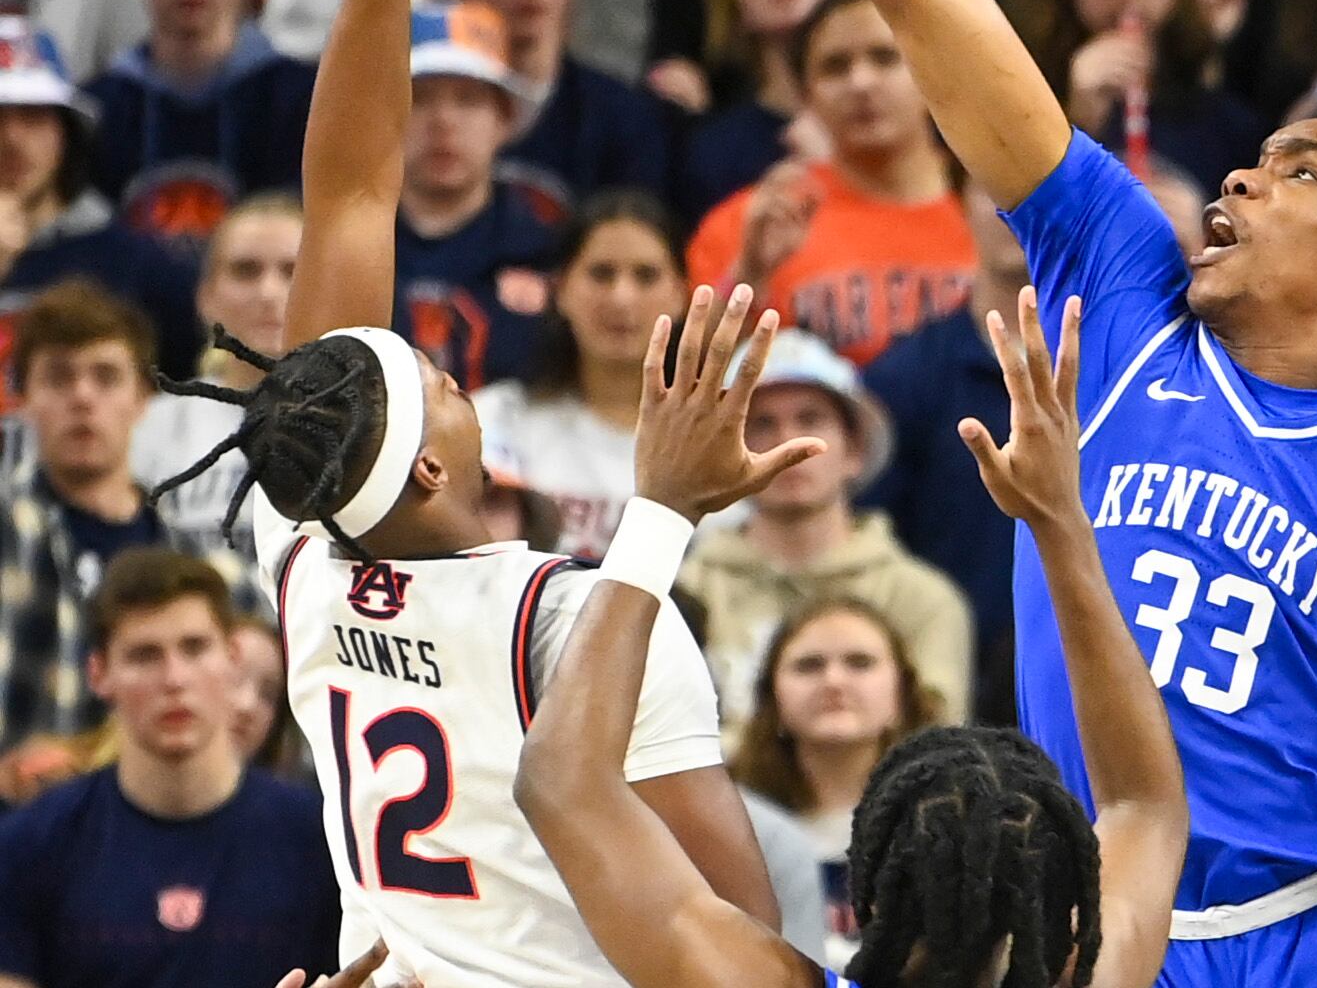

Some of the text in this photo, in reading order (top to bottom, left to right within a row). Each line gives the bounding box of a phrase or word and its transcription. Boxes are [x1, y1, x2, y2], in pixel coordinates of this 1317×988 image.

[333, 624, 441, 689] JONES
[1131, 549, 1276, 714] 33
[328, 684, 480, 900] 12
